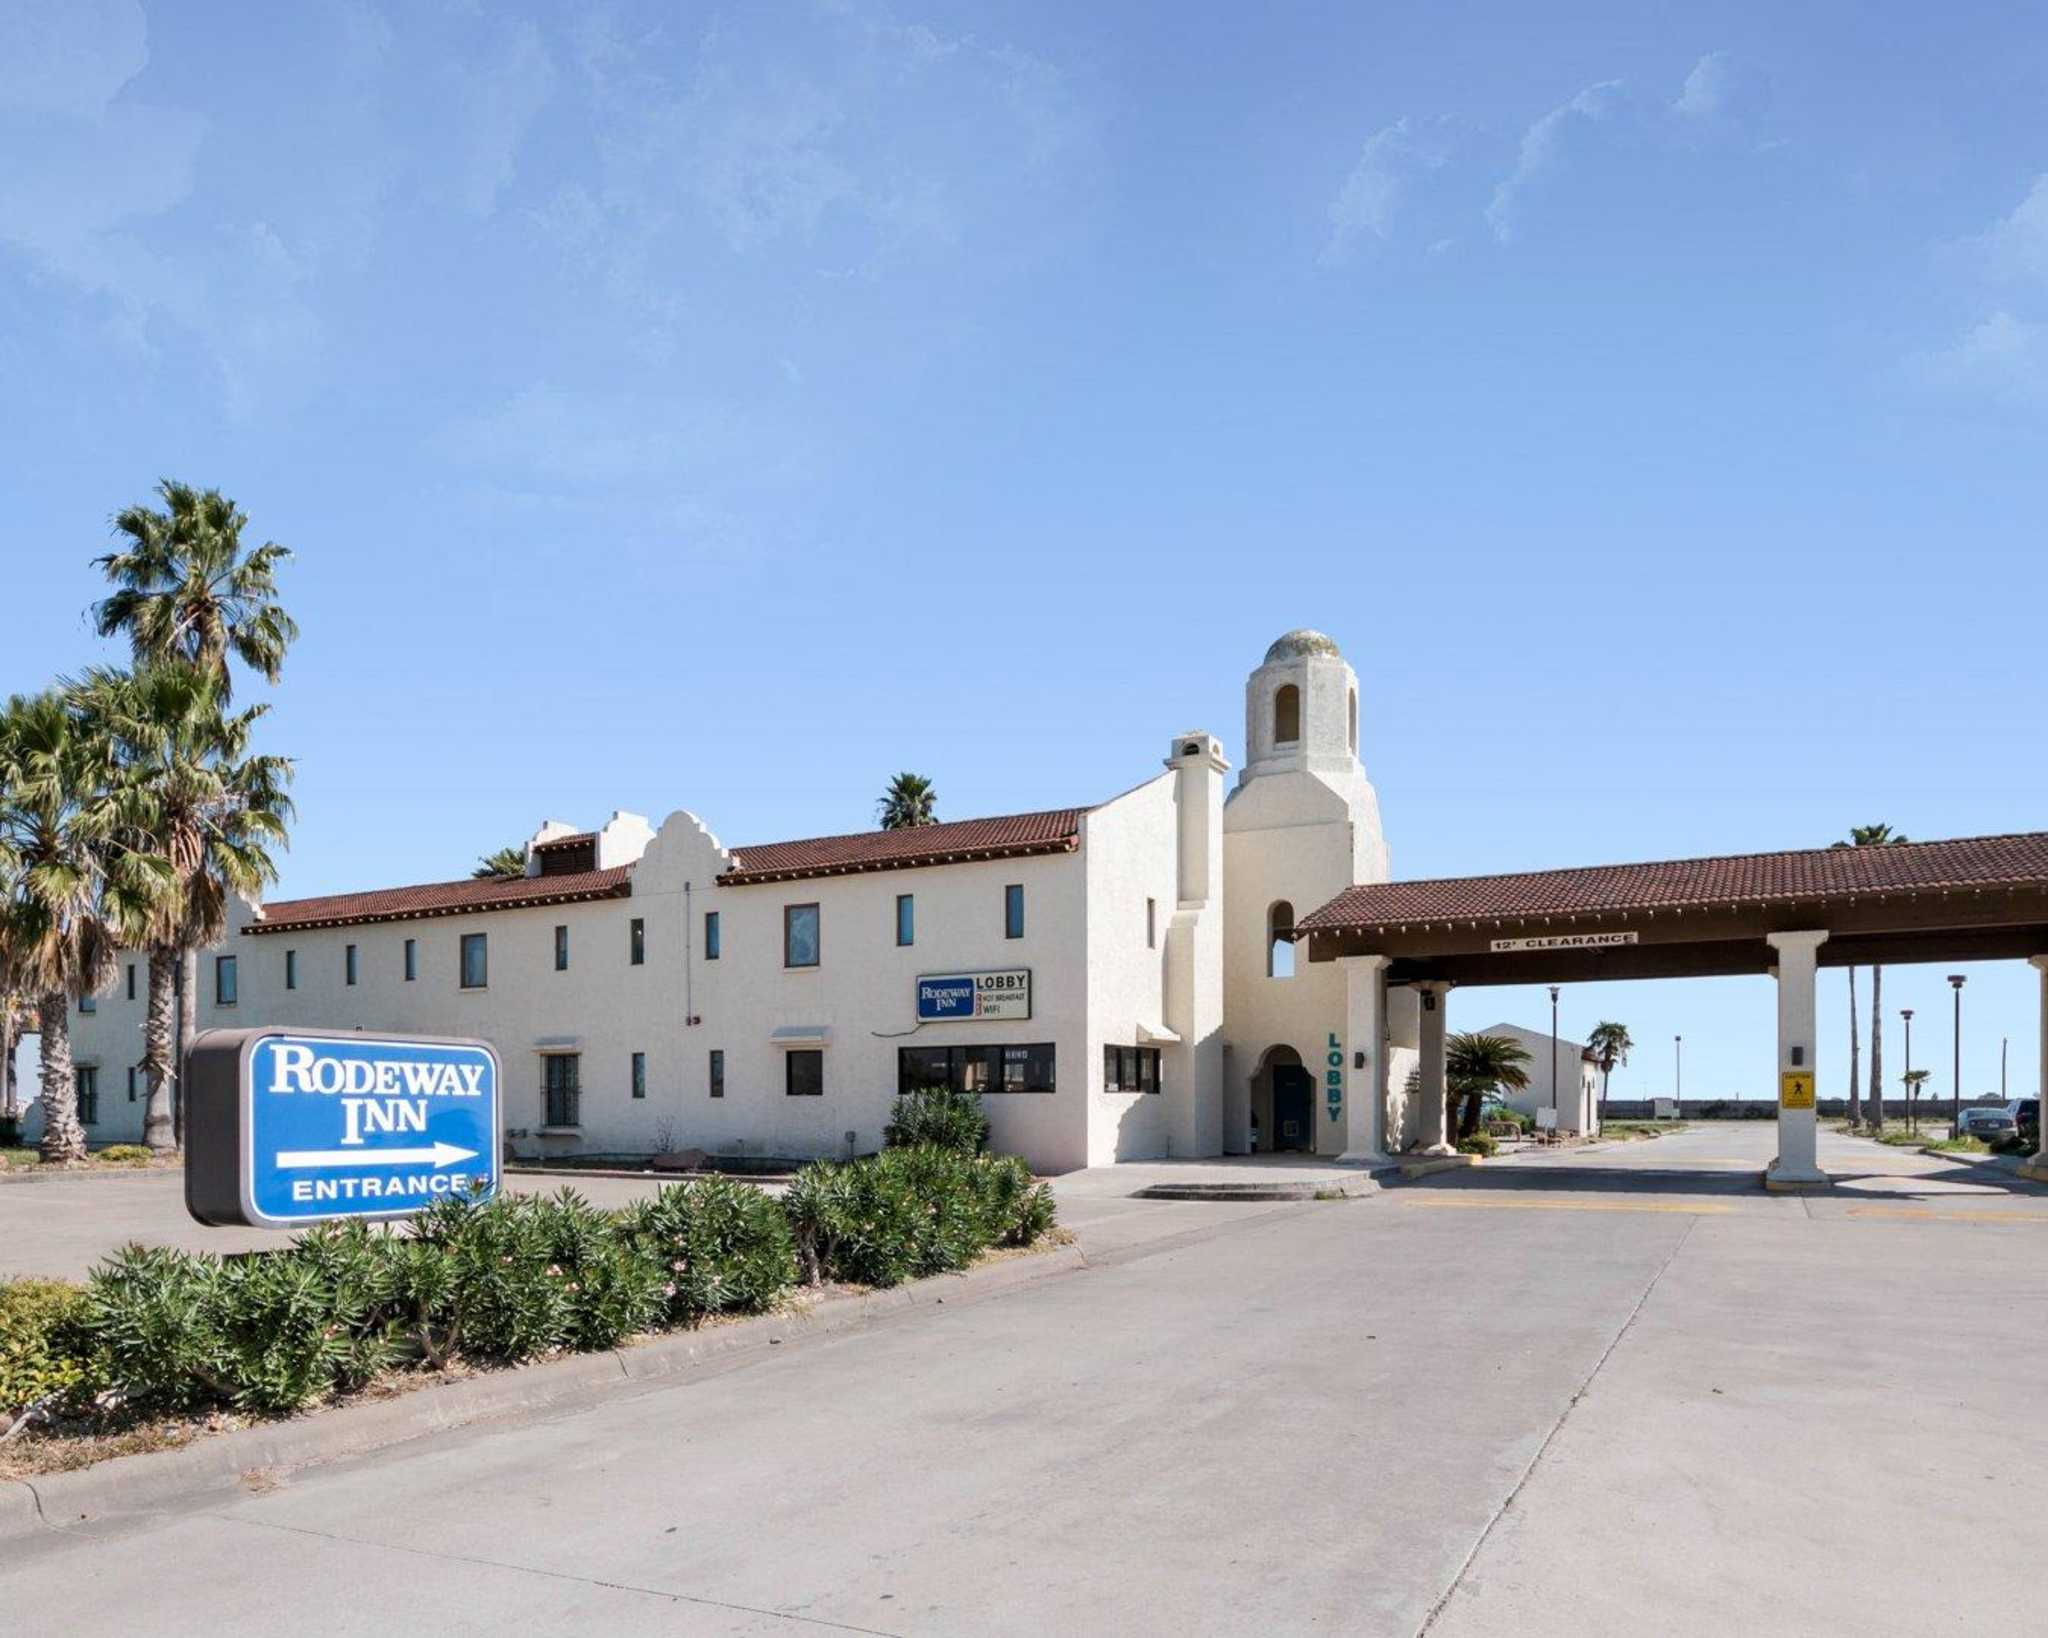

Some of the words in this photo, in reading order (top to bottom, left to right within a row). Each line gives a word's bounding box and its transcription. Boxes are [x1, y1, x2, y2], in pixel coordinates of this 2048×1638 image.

[1526, 934, 1635, 948] CLEARANCE
[976, 975, 1026, 989] LOBBY
[921, 986, 972, 1000] RODEWAY
[936, 999, 957, 1011] INN
[269, 1044, 485, 1096] RODEWAY
[1327, 1033, 1343, 1122] LOBBY
[340, 1098, 428, 1145] INN
[292, 1174, 467, 1200] ENTRANCE
